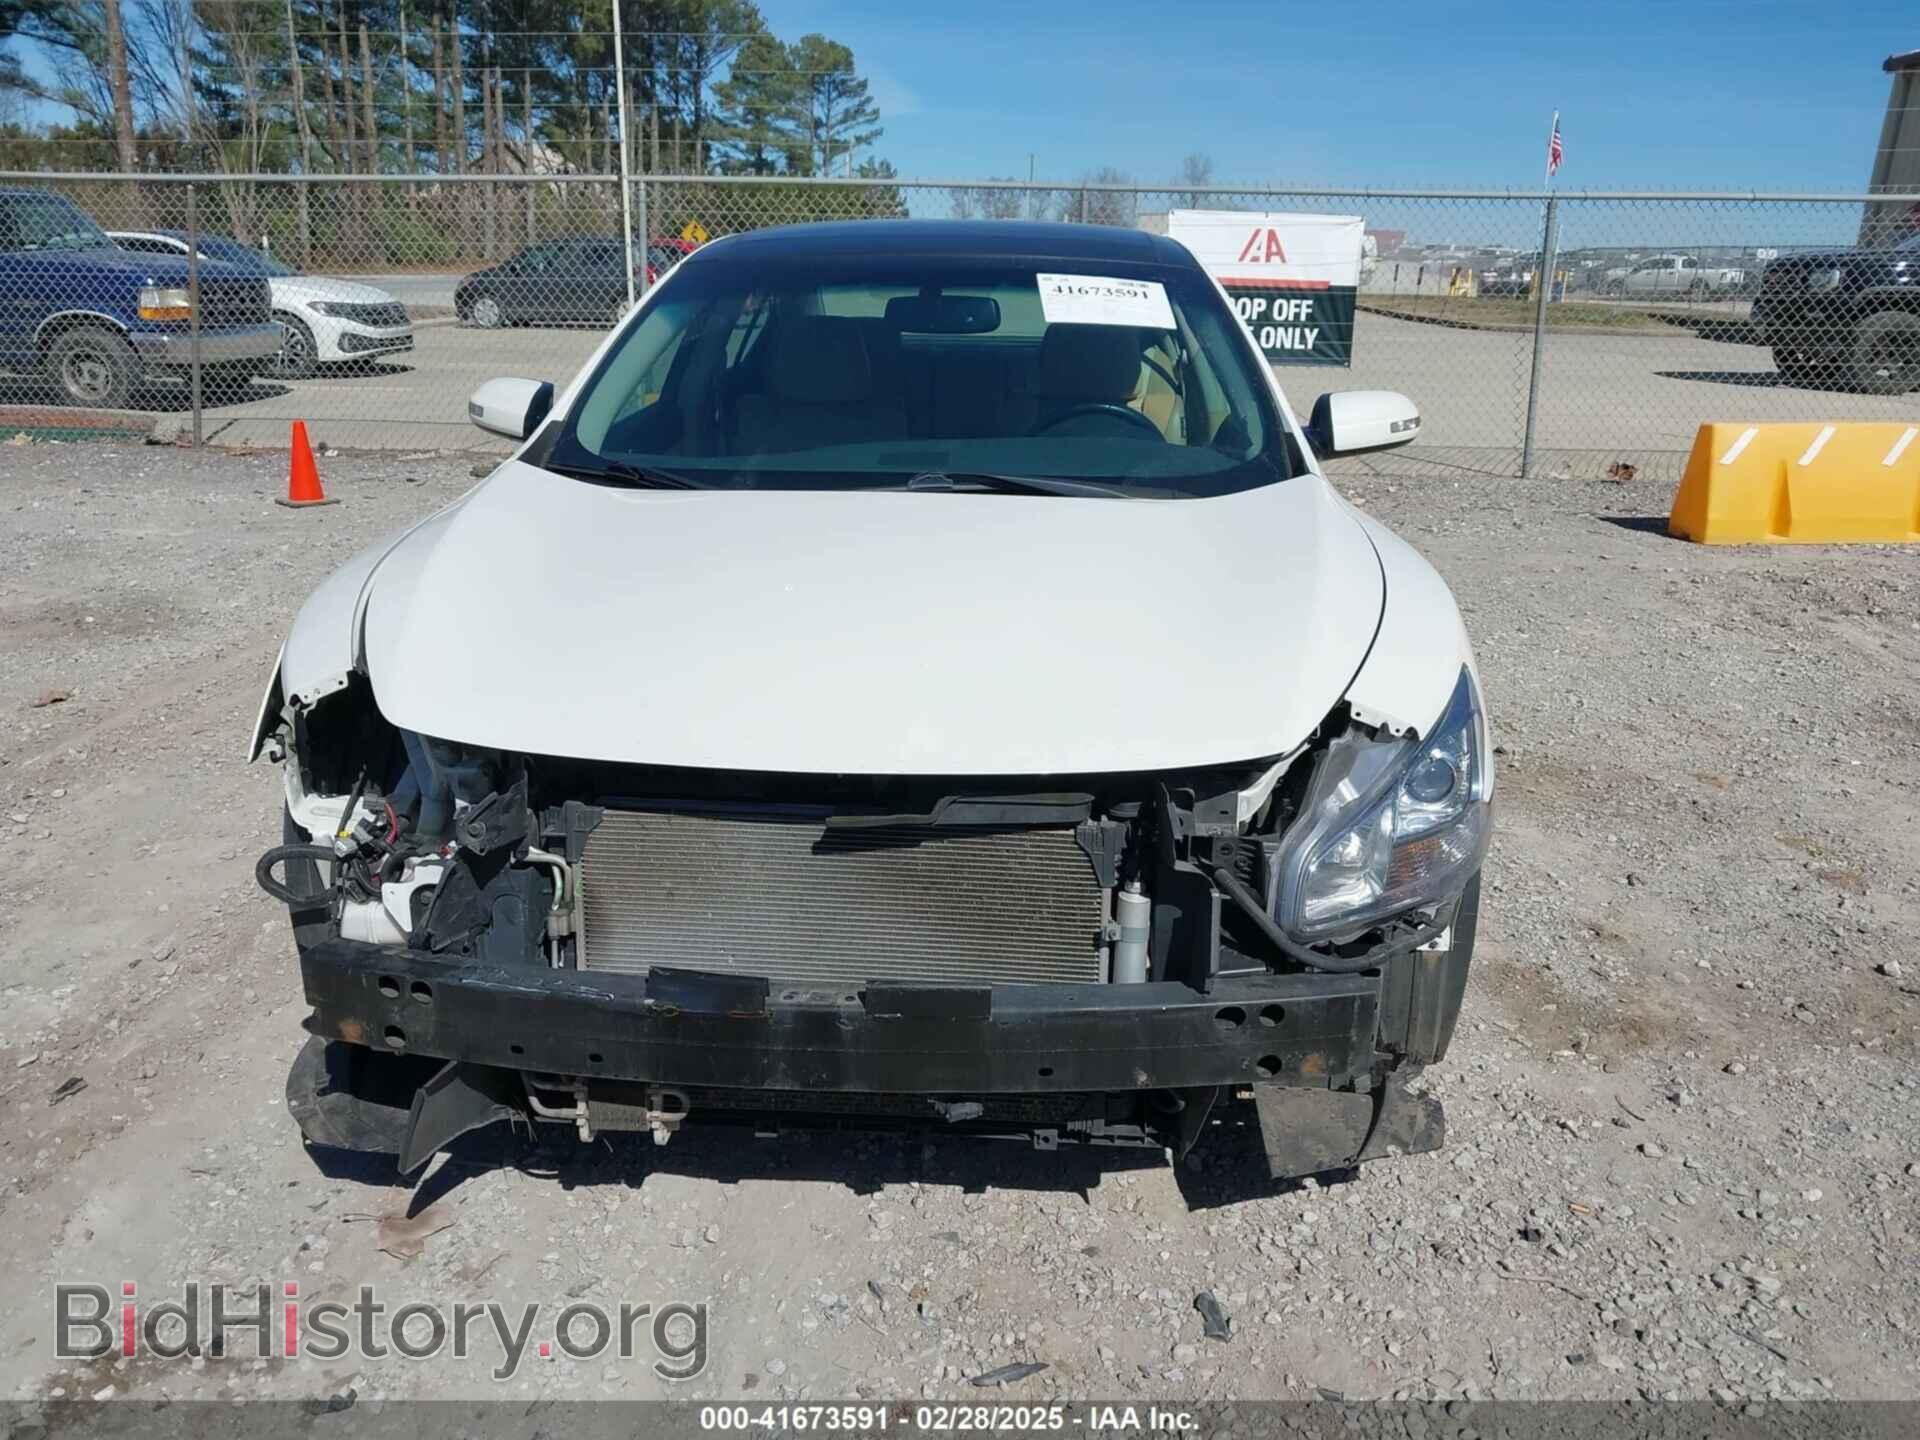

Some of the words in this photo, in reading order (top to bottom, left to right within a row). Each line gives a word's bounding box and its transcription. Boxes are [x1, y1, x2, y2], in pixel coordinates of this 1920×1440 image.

[1051, 285, 1149, 299] 41673591
[1272, 298, 1313, 321] OFF
[1260, 326, 1319, 350] ONLY
